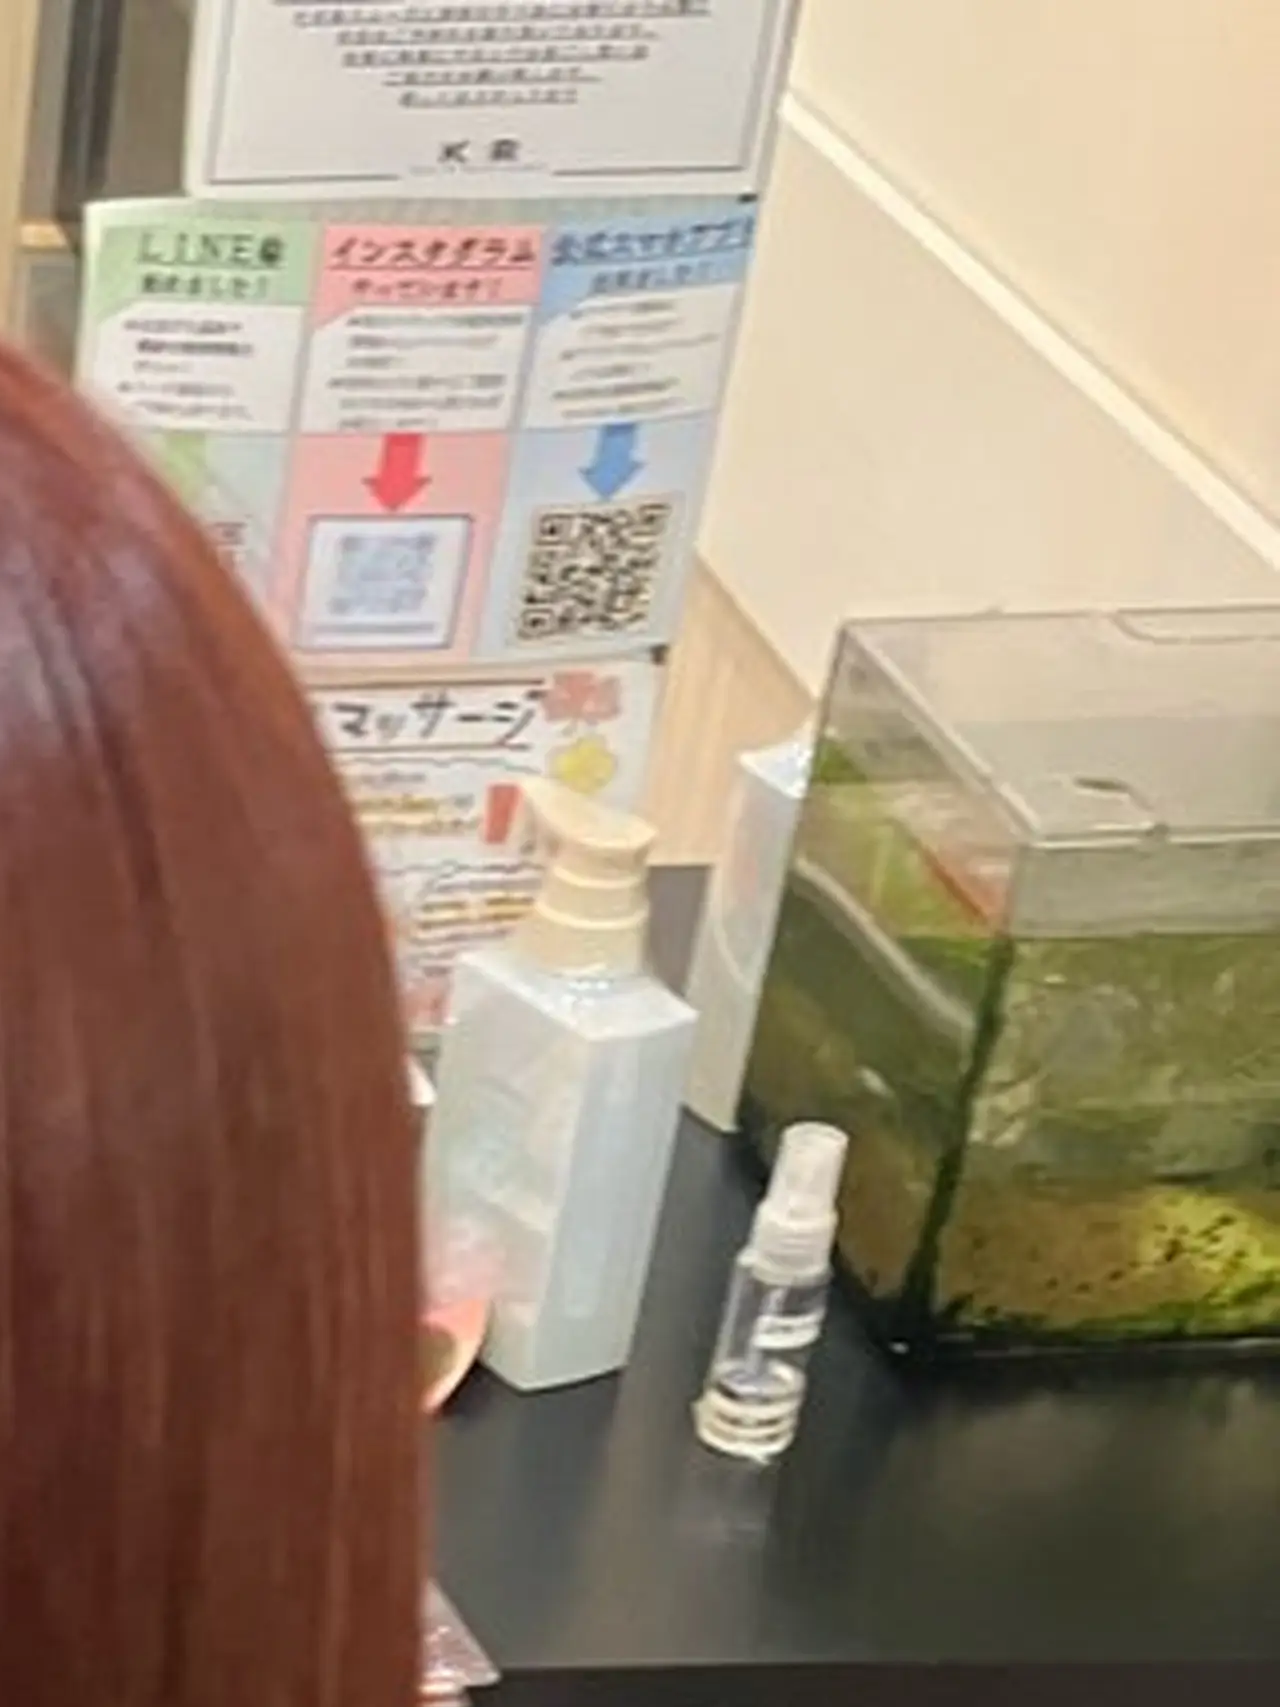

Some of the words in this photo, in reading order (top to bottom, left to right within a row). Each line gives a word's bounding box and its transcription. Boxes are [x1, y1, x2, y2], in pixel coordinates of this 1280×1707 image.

[331, 237, 537, 264] インスタグラム
